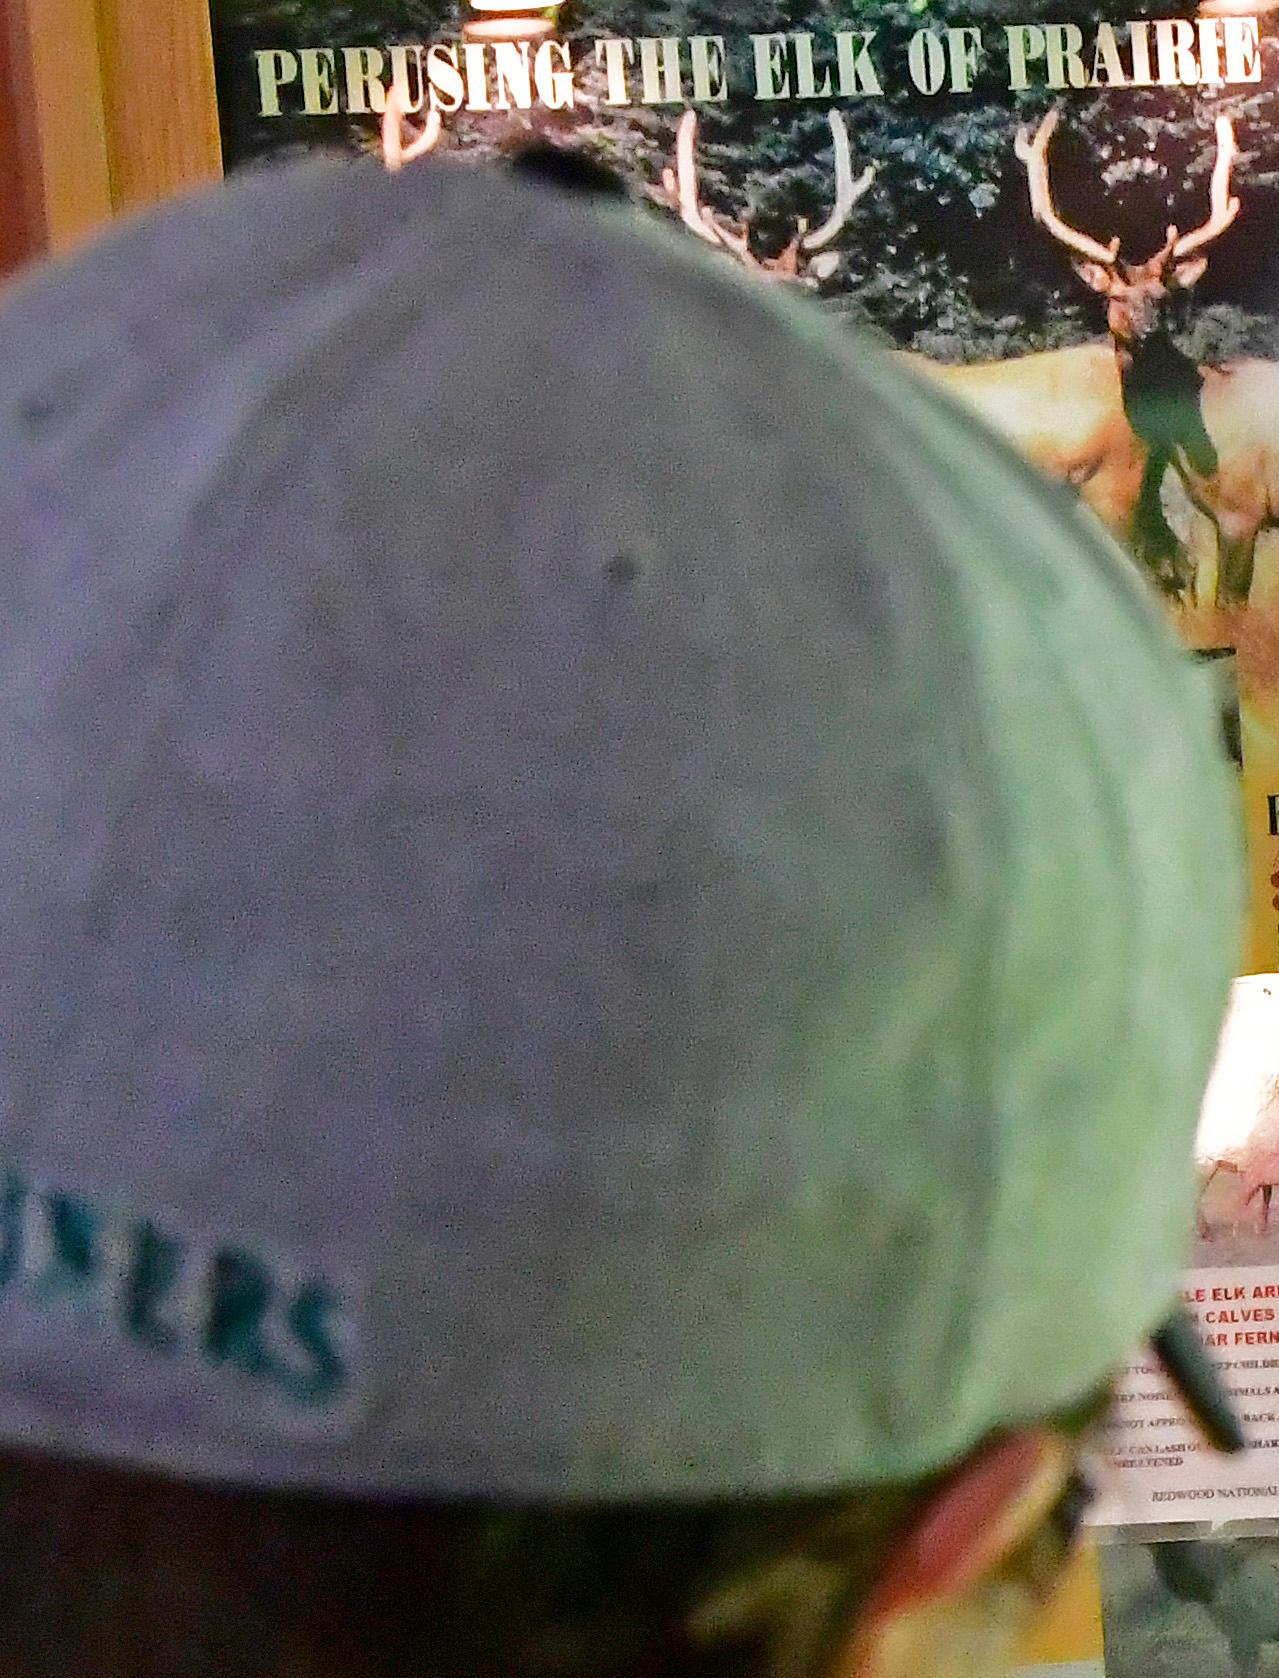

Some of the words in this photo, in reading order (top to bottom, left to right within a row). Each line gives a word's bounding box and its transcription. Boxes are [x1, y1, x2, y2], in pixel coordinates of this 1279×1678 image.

[255, 40, 574, 117] PERUSING
[593, 34, 729, 107] THE
[754, 28, 880, 100] ELK
[908, 24, 982, 95] OF
[1006, 16, 1262, 91] PRAIRIE
[1212, 1287, 1246, 1302] ELK
[1205, 1308, 1276, 1325] CALVES
